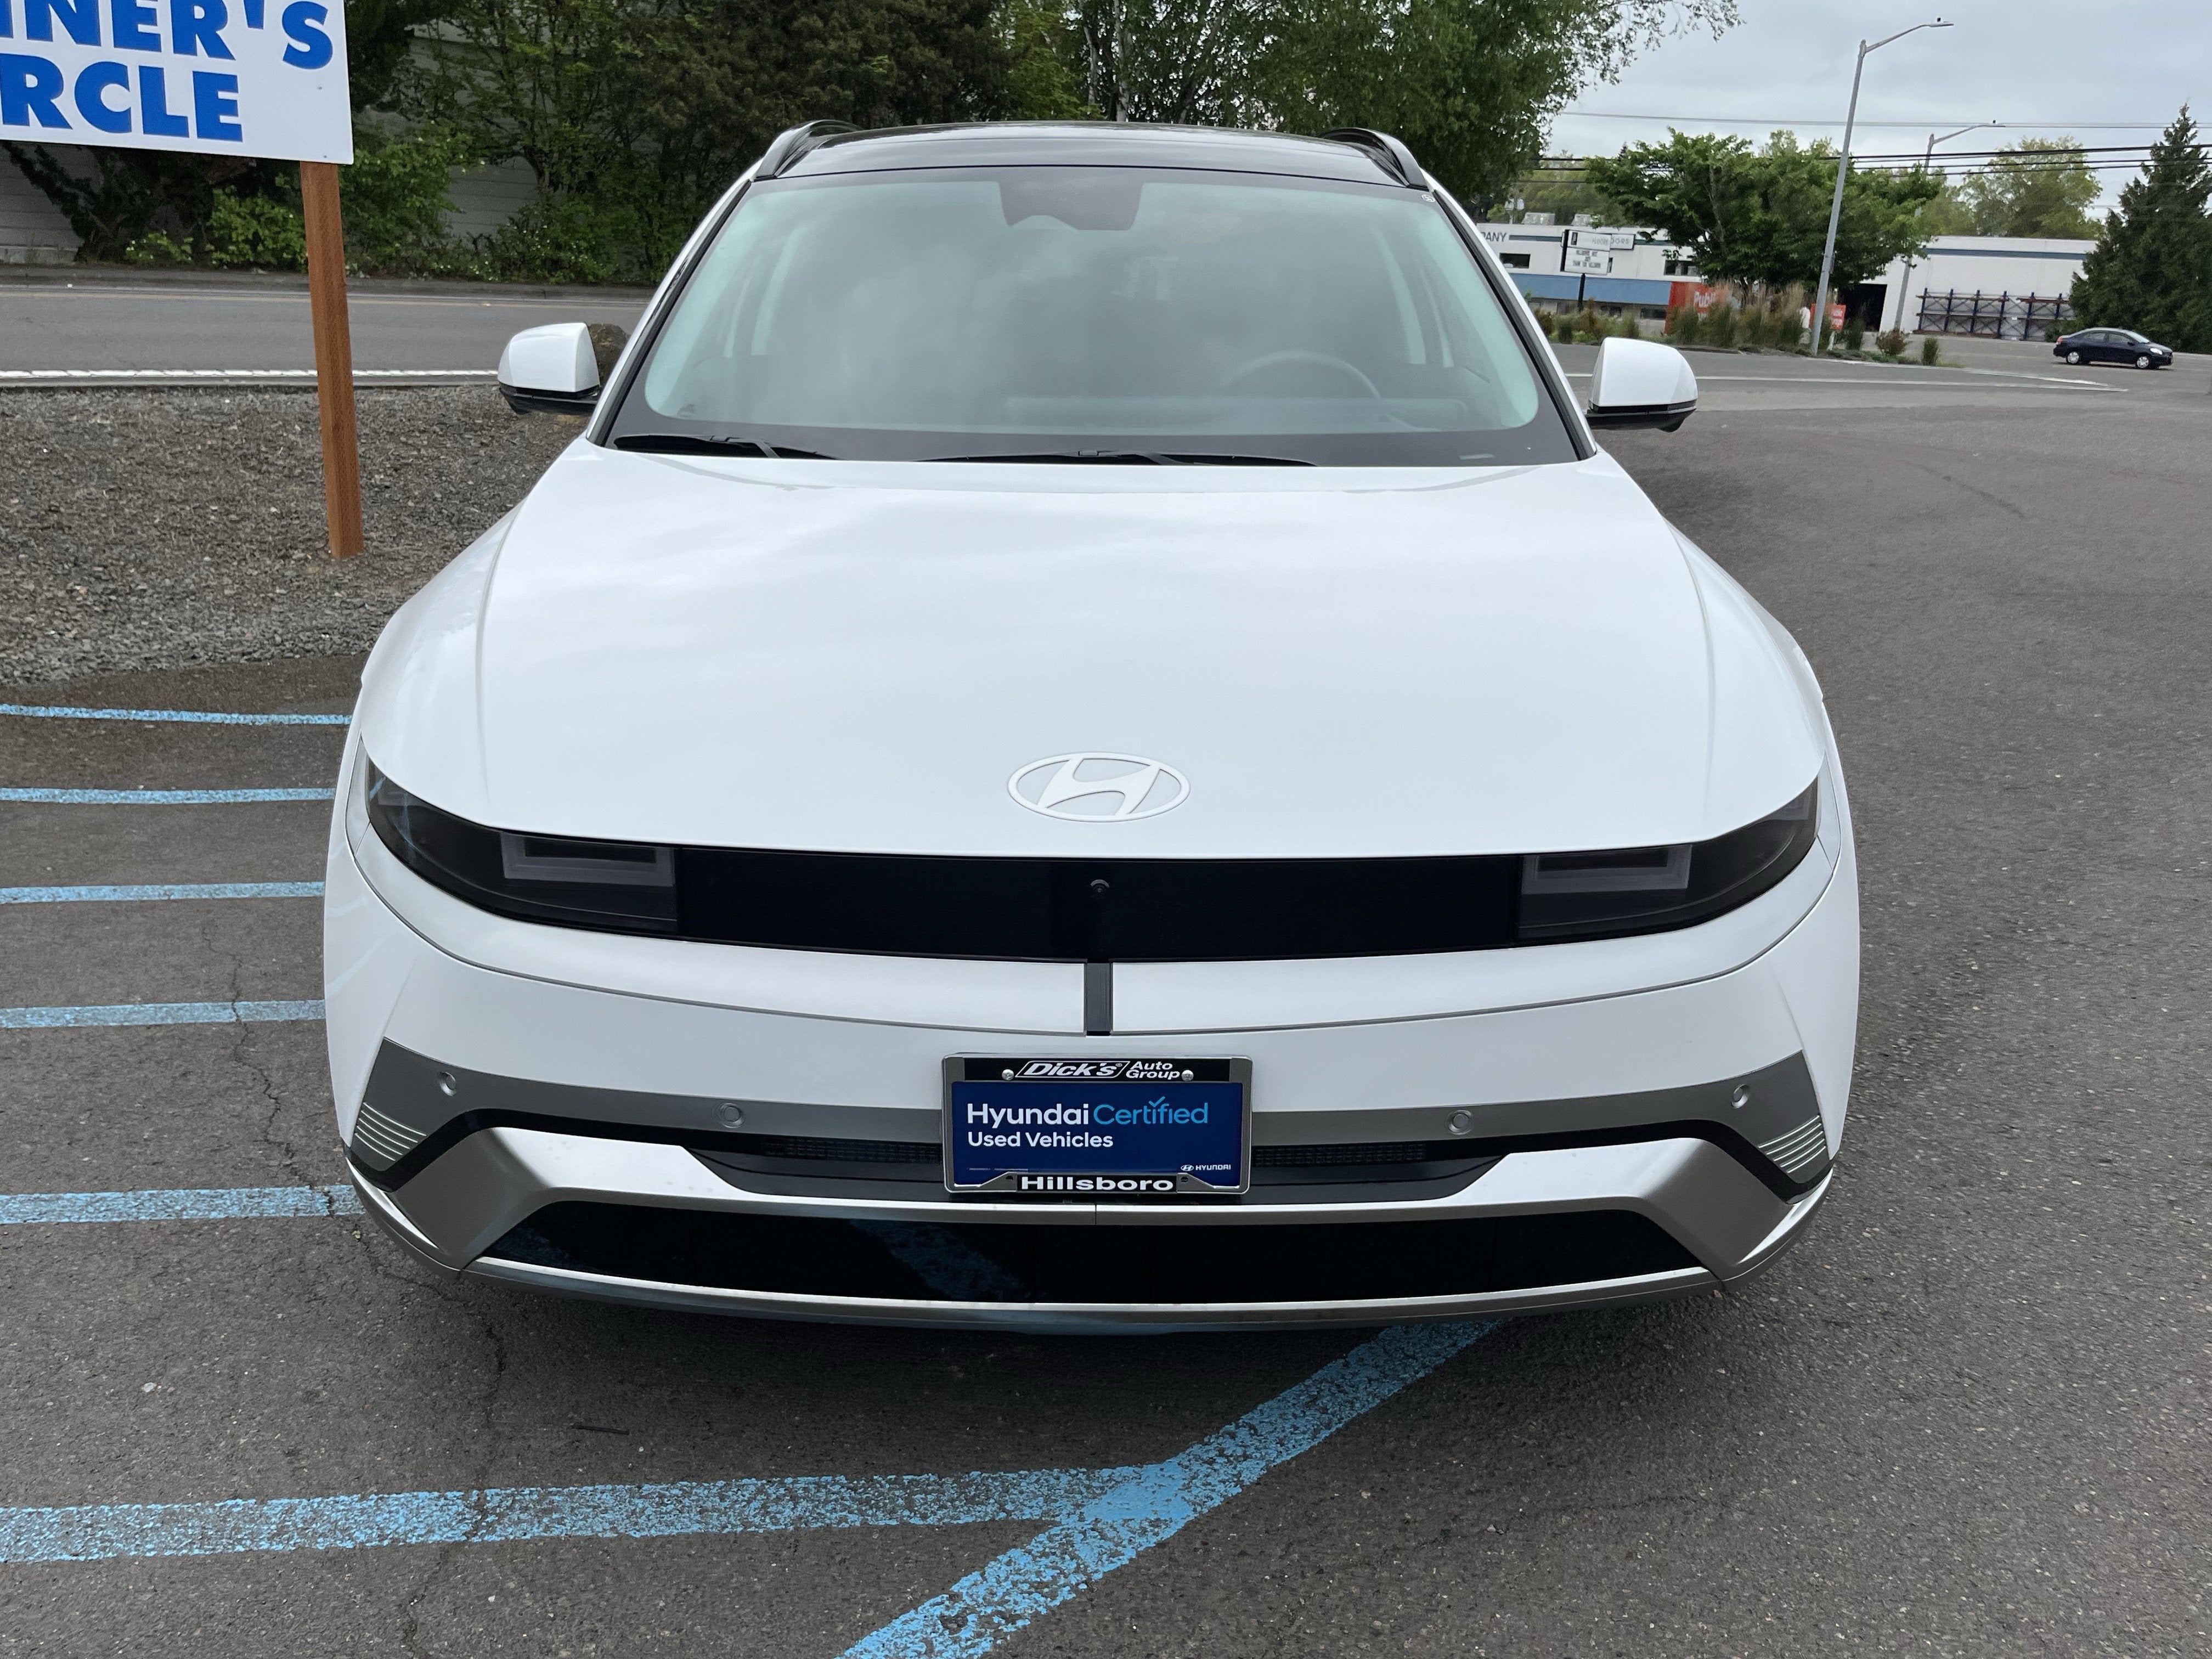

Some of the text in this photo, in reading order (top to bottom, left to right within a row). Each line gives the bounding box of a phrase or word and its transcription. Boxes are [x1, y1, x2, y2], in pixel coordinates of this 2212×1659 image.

[0, 0, 333, 70] NER'S
[1130, 1061, 1173, 1070] Auto
[1125, 1069, 1180, 1080] Group
[967, 1096, 1209, 1128] Hyundai Certified
[968, 1131, 1114, 1148] Used Vehicles
[1021, 1176, 1174, 1190] Hillsboro
